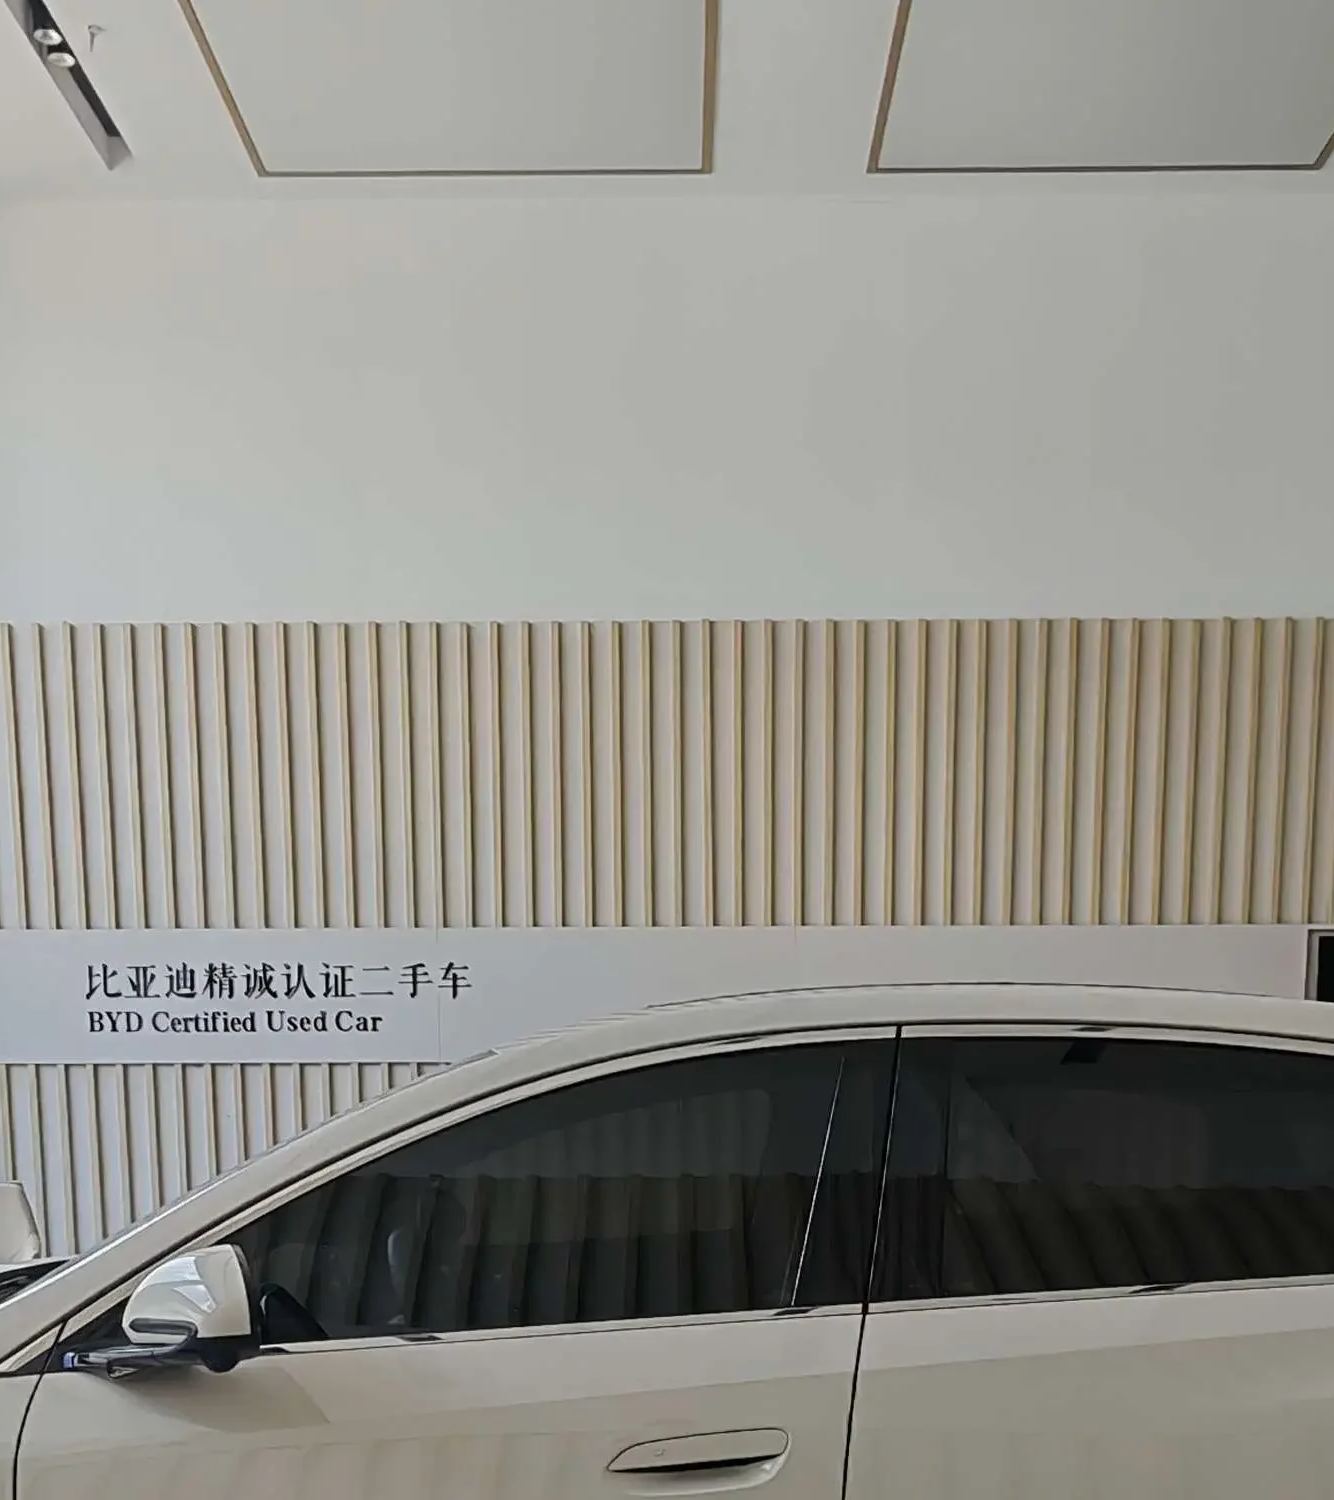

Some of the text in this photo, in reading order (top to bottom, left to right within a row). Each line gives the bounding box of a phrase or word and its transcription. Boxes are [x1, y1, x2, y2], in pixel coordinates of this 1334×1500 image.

[85, 961, 473, 1000] 比亚迪精诚认证二手车
[88, 1010, 383, 1034] BYD Certified Used Car
